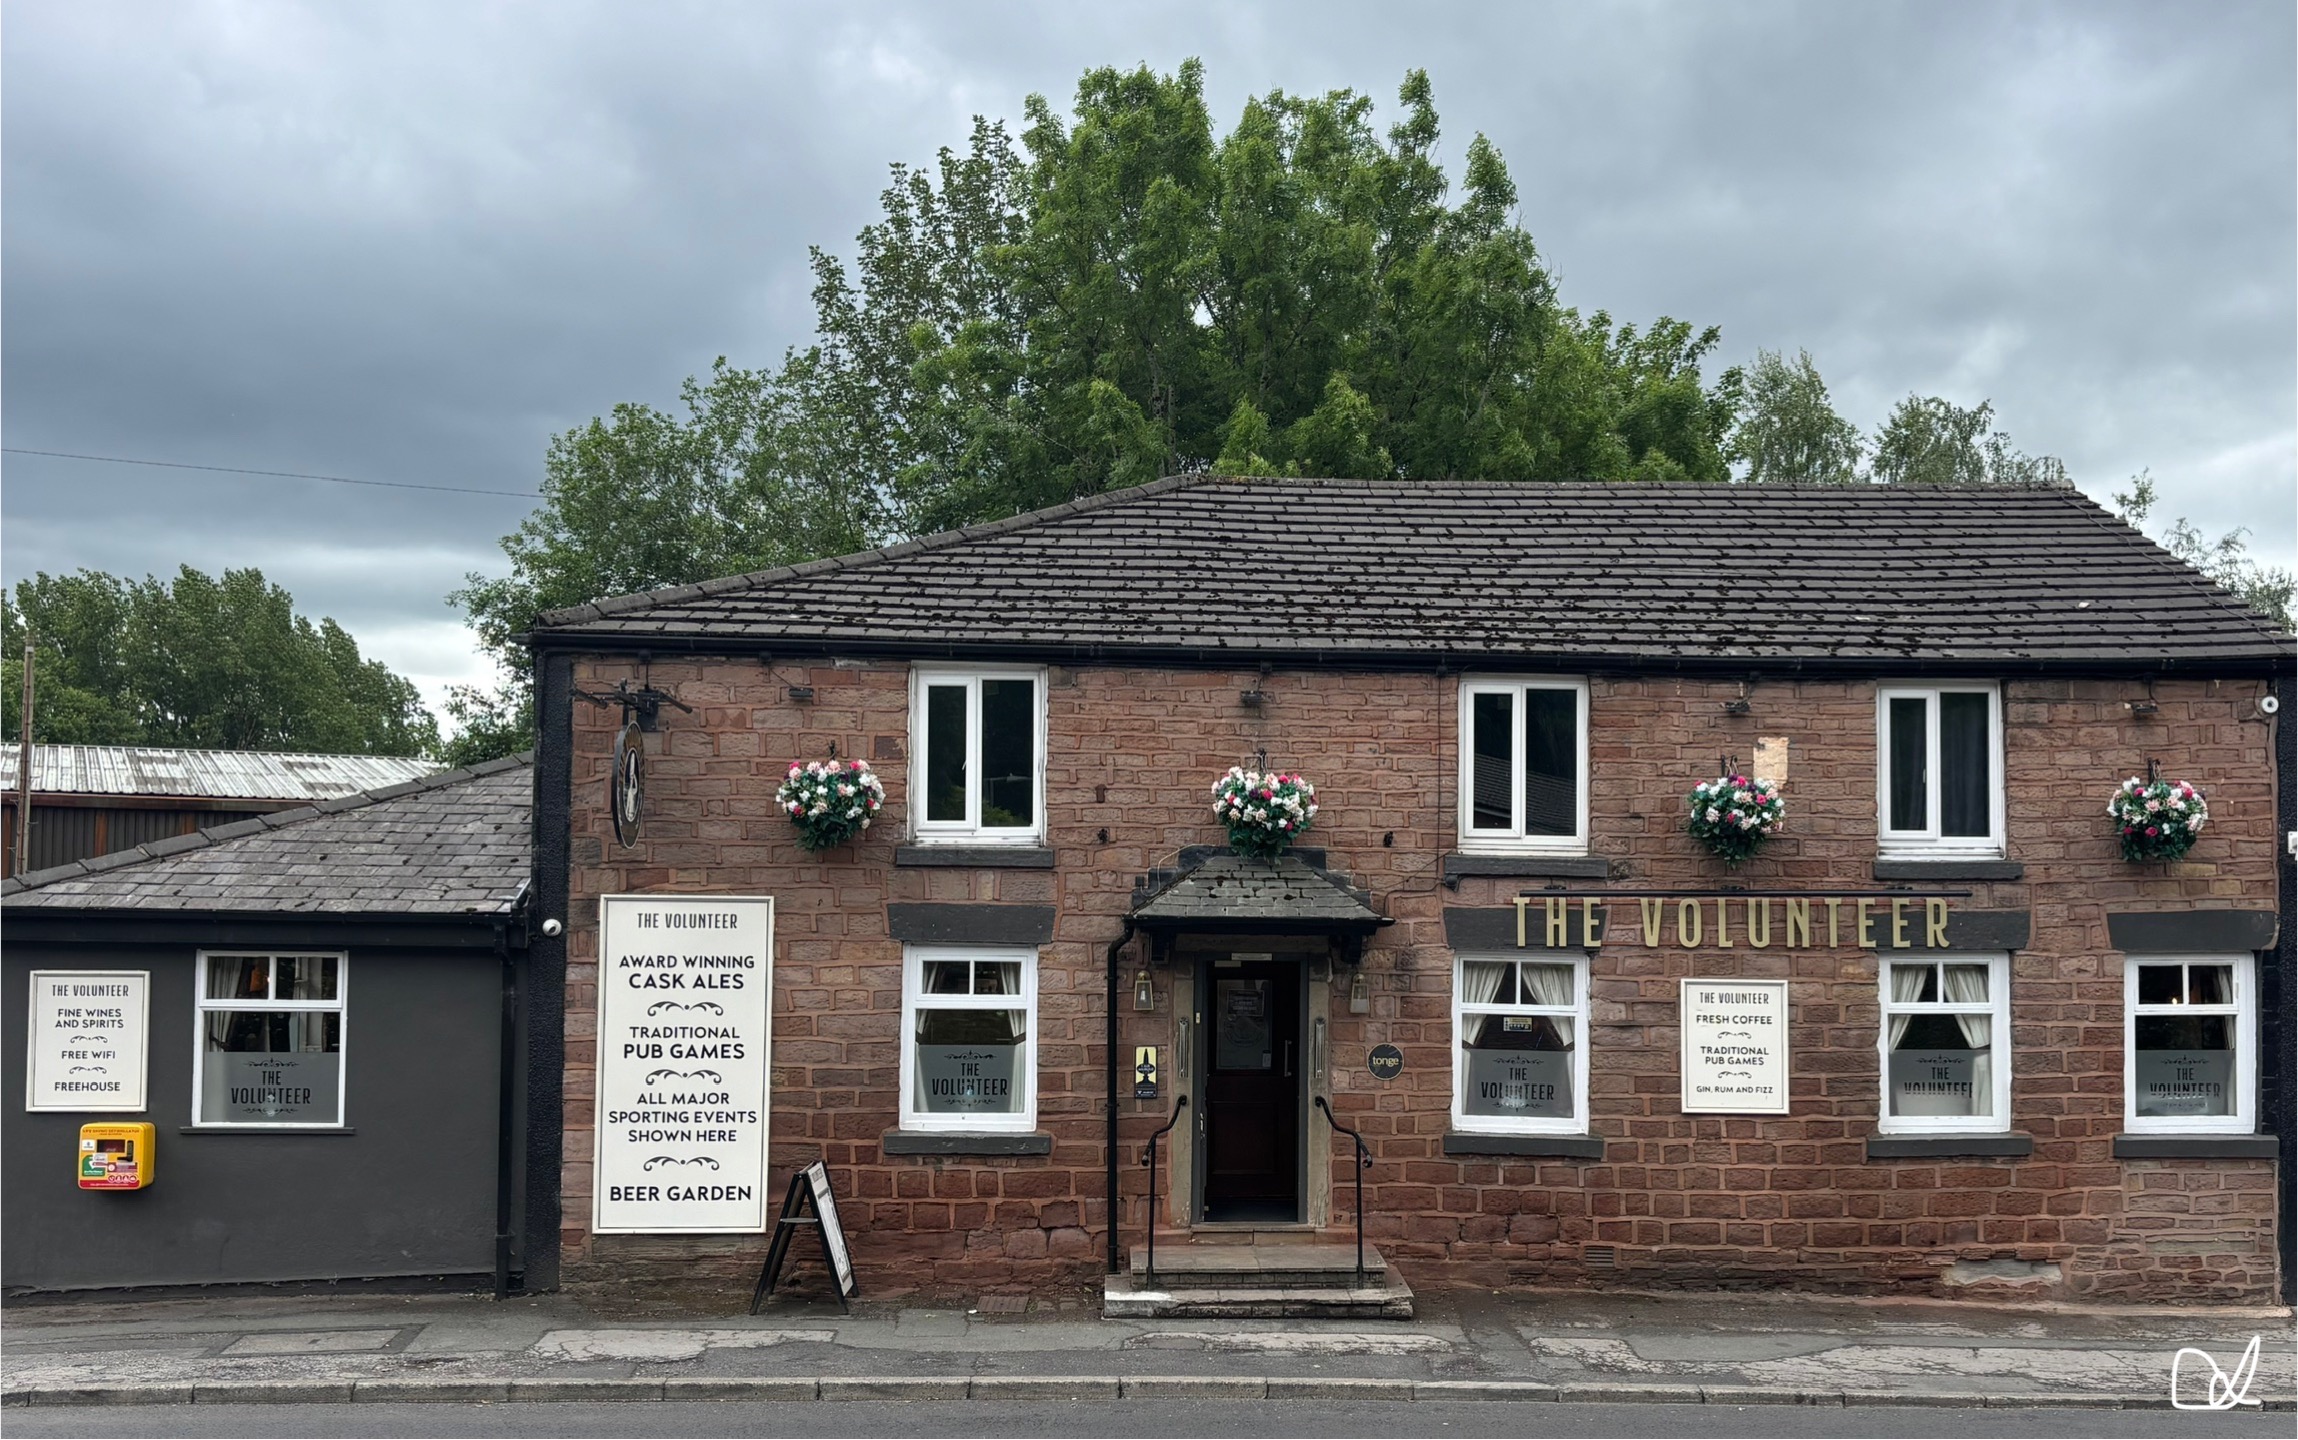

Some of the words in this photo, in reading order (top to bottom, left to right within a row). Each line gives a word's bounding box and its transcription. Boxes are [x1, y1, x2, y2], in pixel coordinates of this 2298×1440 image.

[637, 912, 659, 930] THE
[664, 913, 739, 931] VOLUNTEER
[1513, 896, 1601, 948] THE
[1640, 897, 1950, 949] VOLUNTEER
[619, 955, 677, 970] AWARD
[683, 956, 756, 970] WINNING
[628, 972, 686, 990] CASK
[692, 973, 744, 990] ALES
[52, 984, 69, 997] THE
[73, 984, 129, 997] VOLUNTEER
[1700, 992, 1715, 1004] THE
[1719, 992, 1769, 1005] VOLUNTEER
[58, 1008, 82, 1018] FINE
[85, 1008, 122, 1018] WINES
[1696, 1014, 1730, 1024] FRESH
[1732, 1015, 1773, 1025] COFFEE
[55, 1019, 79, 1028] AND
[82, 1018, 124, 1029] SPIRITS
[629, 1026, 740, 1039] TRADITIONAL
[61, 1050, 88, 1060] FREE
[91, 1050, 116, 1059] WIFI
[623, 1043, 664, 1060] PUB
[669, 1043, 745, 1060] GAMES
[1700, 1046, 1769, 1055] TRADITIONAL
[1372, 1055, 1399, 1068] tonge
[1705, 1056, 1725, 1065] PUB
[1727, 1056, 1764, 1066] GAMES
[961, 1062, 980, 1077] THE
[1509, 1067, 1528, 1081] THE
[1931, 1066, 1950, 1080] THE
[2176, 1067, 2195, 1081] THE
[262, 1070, 282, 1086] THE
[54, 1081, 121, 1092] FREEHOUSE
[931, 1078, 1008, 1096] VOLUNTEER
[1696, 1085, 1713, 1094] GIN,
[1714, 1086, 1734, 1094] RUM
[1735, 1086, 1754, 1094] AND
[1755, 1086, 1773, 1094] FIZZ
[231, 1087, 311, 1105] VOLUNTEER
[636, 1092, 667, 1105] ALL
[671, 1092, 730, 1105] MAJOR
[608, 1110, 690, 1124] SPORTING
[694, 1110, 757, 1124] EVENTS
[628, 1129, 692, 1143] SHOWN
[696, 1129, 737, 1142] HERE
[610, 1185, 662, 1202] BEER
[666, 1185, 752, 1203] GARDEN
